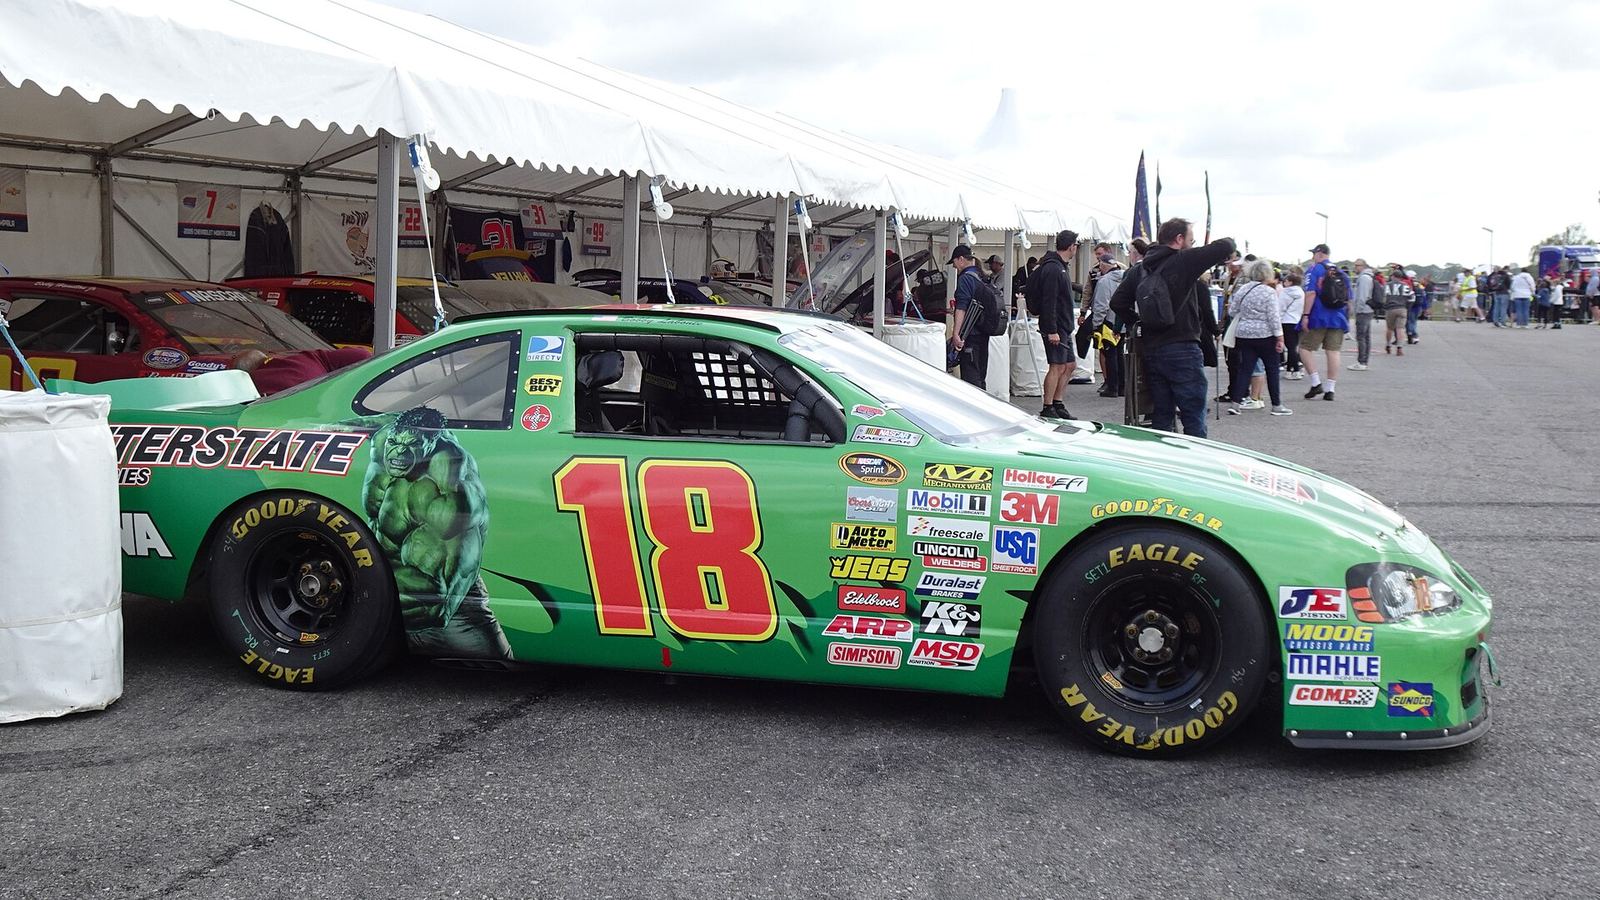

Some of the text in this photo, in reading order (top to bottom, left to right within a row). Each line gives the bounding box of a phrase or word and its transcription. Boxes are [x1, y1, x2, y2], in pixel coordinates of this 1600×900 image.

[206, 190, 217, 219] 7
[405, 207, 421, 231] 22
[530, 204, 547, 225] 31
[593, 222, 604, 242] 99
[186, 290, 252, 303] NASCAR
[188, 360, 227, 369] Goody's
[530, 378, 561, 386] BEST
[110, 425, 367, 476] TERSTATE
[857, 457, 883, 465] NASCAR
[861, 465, 884, 474] Sprint
[924, 478, 992, 491] MECHANIX WEAR
[1005, 469, 1056, 485] Holley
[912, 491, 963, 509] Mobil
[1001, 492, 1059, 524] 3M
[852, 526, 886, 537] Auto
[929, 527, 984, 540] freescale
[552, 455, 780, 642] 18
[849, 536, 893, 548] Meter
[917, 543, 975, 558] LINCOLN
[995, 529, 1036, 565] USG
[931, 558, 981, 569] WELDERS
[1109, 543, 1204, 571] EAGLE
[830, 555, 911, 582] JEGS
[992, 563, 1035, 574] SHEETROCK
[922, 574, 982, 590] Duralast
[843, 591, 900, 608] Edelbrock
[931, 589, 964, 598] BRAKES
[1280, 589, 1341, 616] JE
[826, 616, 911, 636] ARP
[1287, 624, 1374, 642] MOOG
[913, 640, 979, 661] MSD
[1289, 640, 1371, 652] CHASSIS PARTS
[833, 646, 894, 665] SIMPSON
[240, 649, 315, 684] EAGLE
[1289, 654, 1379, 677] MAHLE
[1296, 687, 1358, 702] COMP
[1392, 696, 1432, 705] SUNOCO
